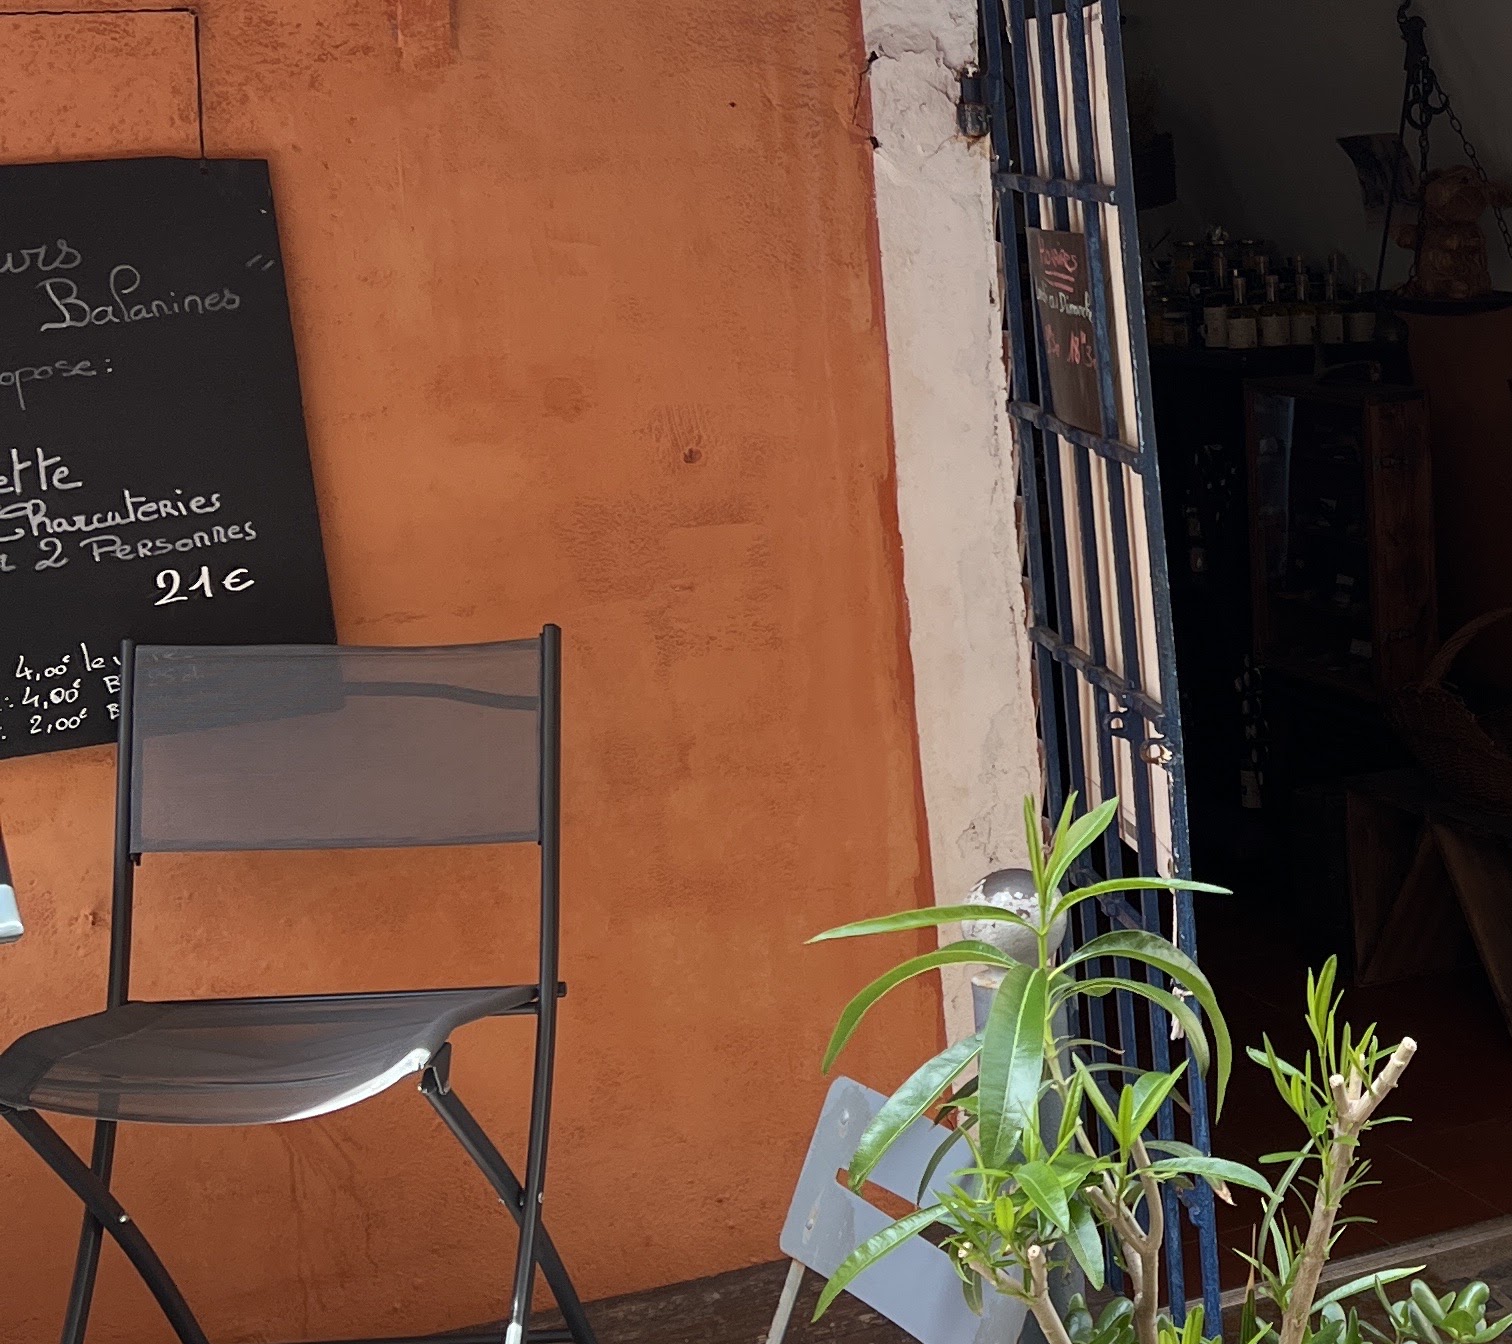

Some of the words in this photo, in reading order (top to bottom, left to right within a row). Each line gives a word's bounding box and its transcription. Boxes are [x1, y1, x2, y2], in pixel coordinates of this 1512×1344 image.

[35, 264, 242, 332] Balanines
[34, 537, 69, 571] 2
[153, 565, 255, 606] 21€
